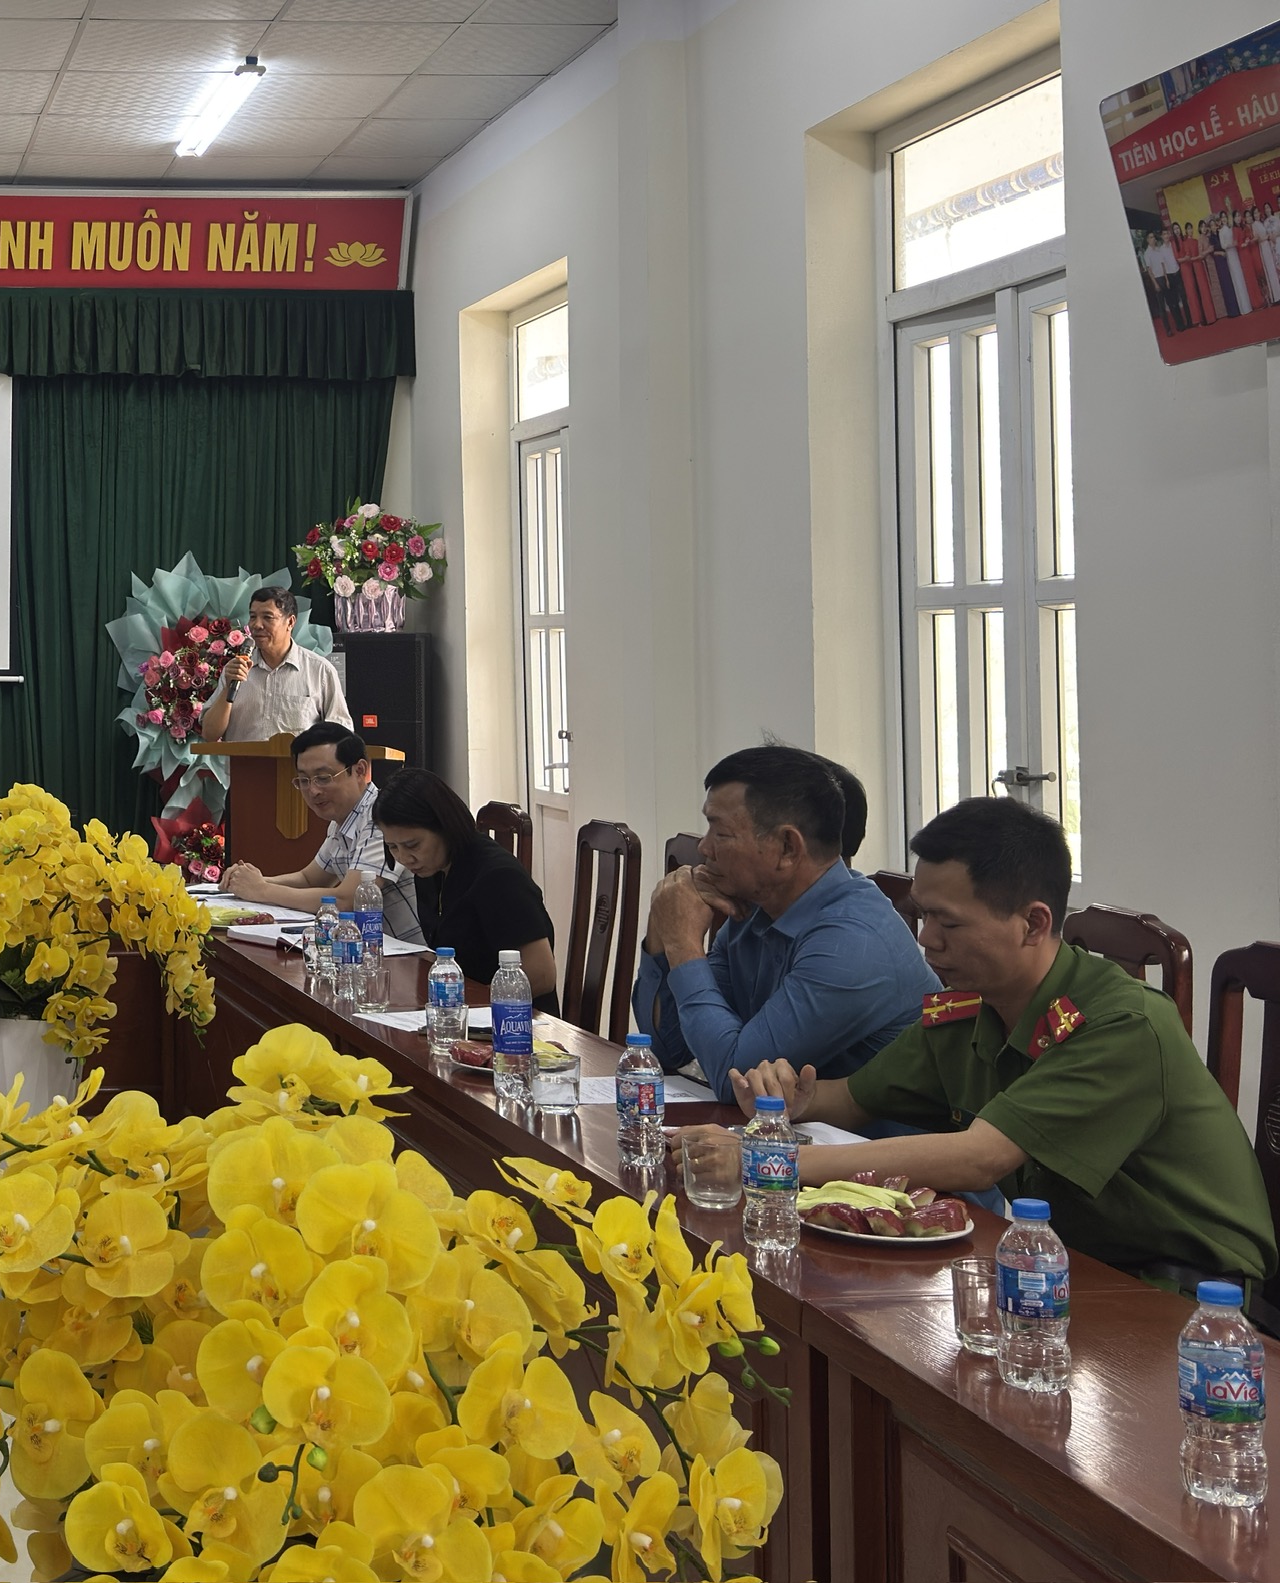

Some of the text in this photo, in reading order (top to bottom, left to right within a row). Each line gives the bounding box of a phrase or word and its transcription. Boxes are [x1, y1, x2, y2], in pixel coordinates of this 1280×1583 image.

[1118, 142, 1157, 172] TIÊN
[1159, 126, 1198, 158] HỌC
[1200, 104, 1224, 142] LỄ
[1237, 93, 1280, 128] HẬU
[70, 209, 191, 272] MUÔN
[206, 210, 317, 273] NĂM!
[757, 1162, 793, 1176] laVie
[1206, 1380, 1259, 1401] laVie
